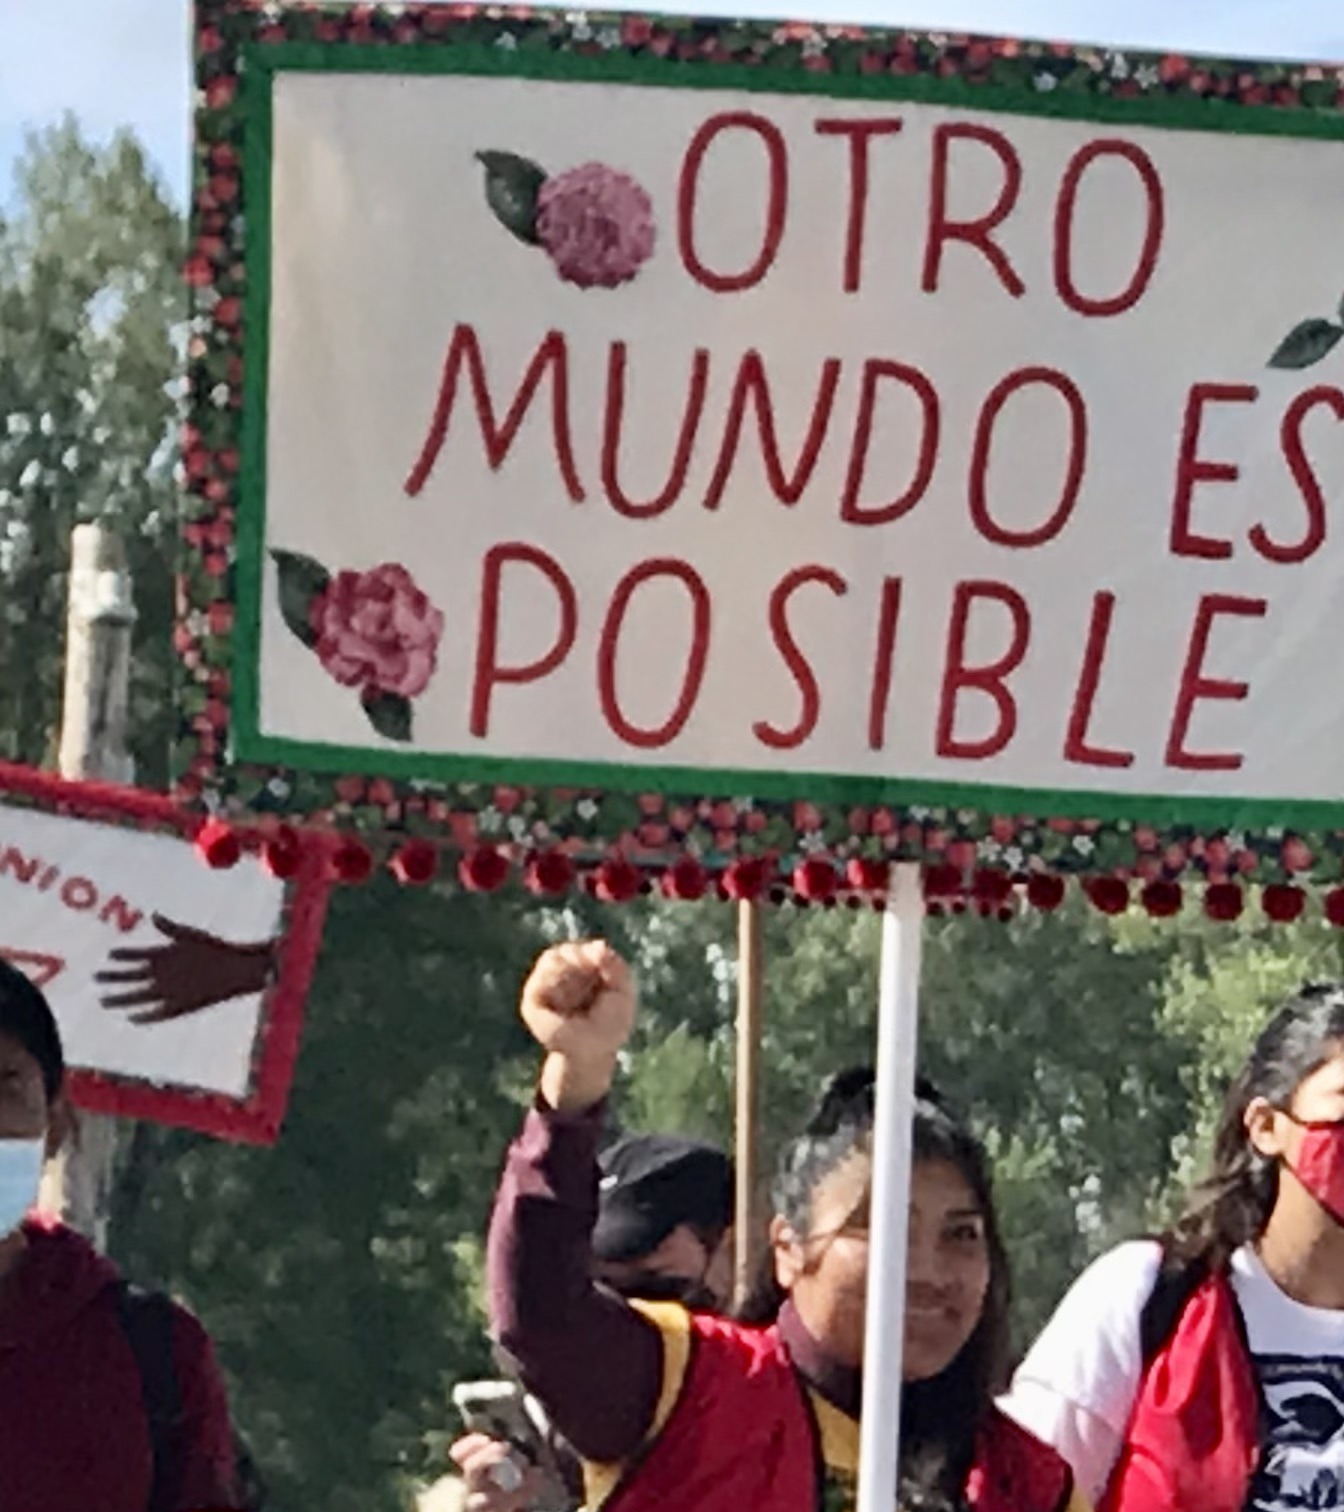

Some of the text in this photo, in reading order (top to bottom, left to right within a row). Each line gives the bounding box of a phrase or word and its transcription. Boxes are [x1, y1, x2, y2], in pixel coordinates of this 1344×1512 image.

[677, 110, 1165, 318] OTRO
[404, 322, 1090, 549] MUNDO
[468, 541, 1270, 770] POSIBLE
